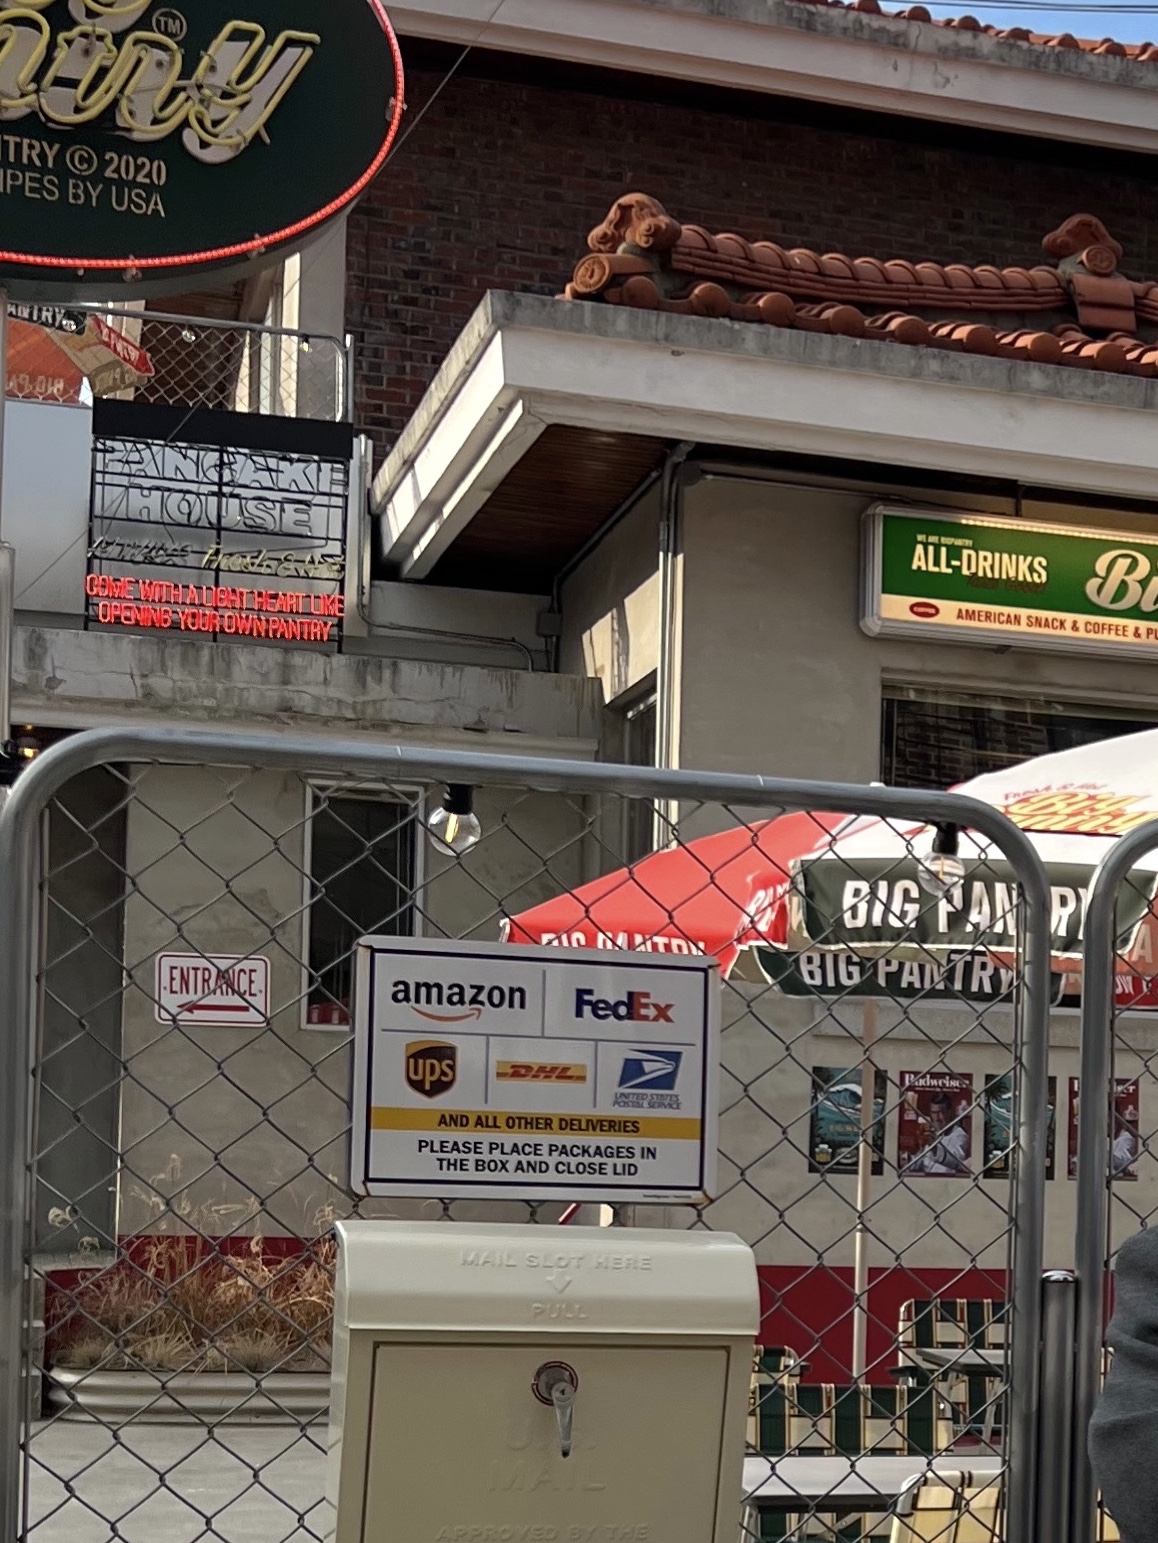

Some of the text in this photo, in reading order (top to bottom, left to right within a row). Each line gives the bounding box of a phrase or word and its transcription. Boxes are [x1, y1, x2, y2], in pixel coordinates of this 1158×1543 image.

[0, 134, 61, 169] TRY
[104, 151, 167, 187] 2020
[68, 178, 103, 208] BY
[111, 187, 166, 218] USA
[126, 483, 313, 535] HOUSE
[911, 543, 1048, 585] ALL-DRINKS
[86, 574, 347, 617] COME WITH A LIGHT HEART LIKE
[98, 601, 333, 641] OPENING YOUR OWN PANTRY
[956, 608, 1022, 627] AMERICAN
[1026, 615, 1067, 631] SNACK
[1071, 620, 1080, 633] &
[1084, 621, 1129, 638] COFFEE
[1133, 627, 1142, 639] &
[842, 879, 921, 928] BIG
[937, 879, 1089, 940] PANR
[168, 965, 258, 997] ENTRANCE
[800, 950, 1015, 994] BIG PANTRY
[391, 979, 676, 1024] amazon FedEx
[408, 1057, 576, 1091] ups DHL
[437, 1113, 641, 1135] AND ALL OTHER DELIVERIES
[417, 1139, 657, 1160] PLEASE PLACE PACKAGES IN
[436, 1157, 638, 1177] THE BOX AND CLOSE LID
[459, 1250, 652, 1271] MAIL SLOT HERE
[531, 1302, 589, 1320] PULL
[434, 1523, 650, 1542] APPROVED BY THE
